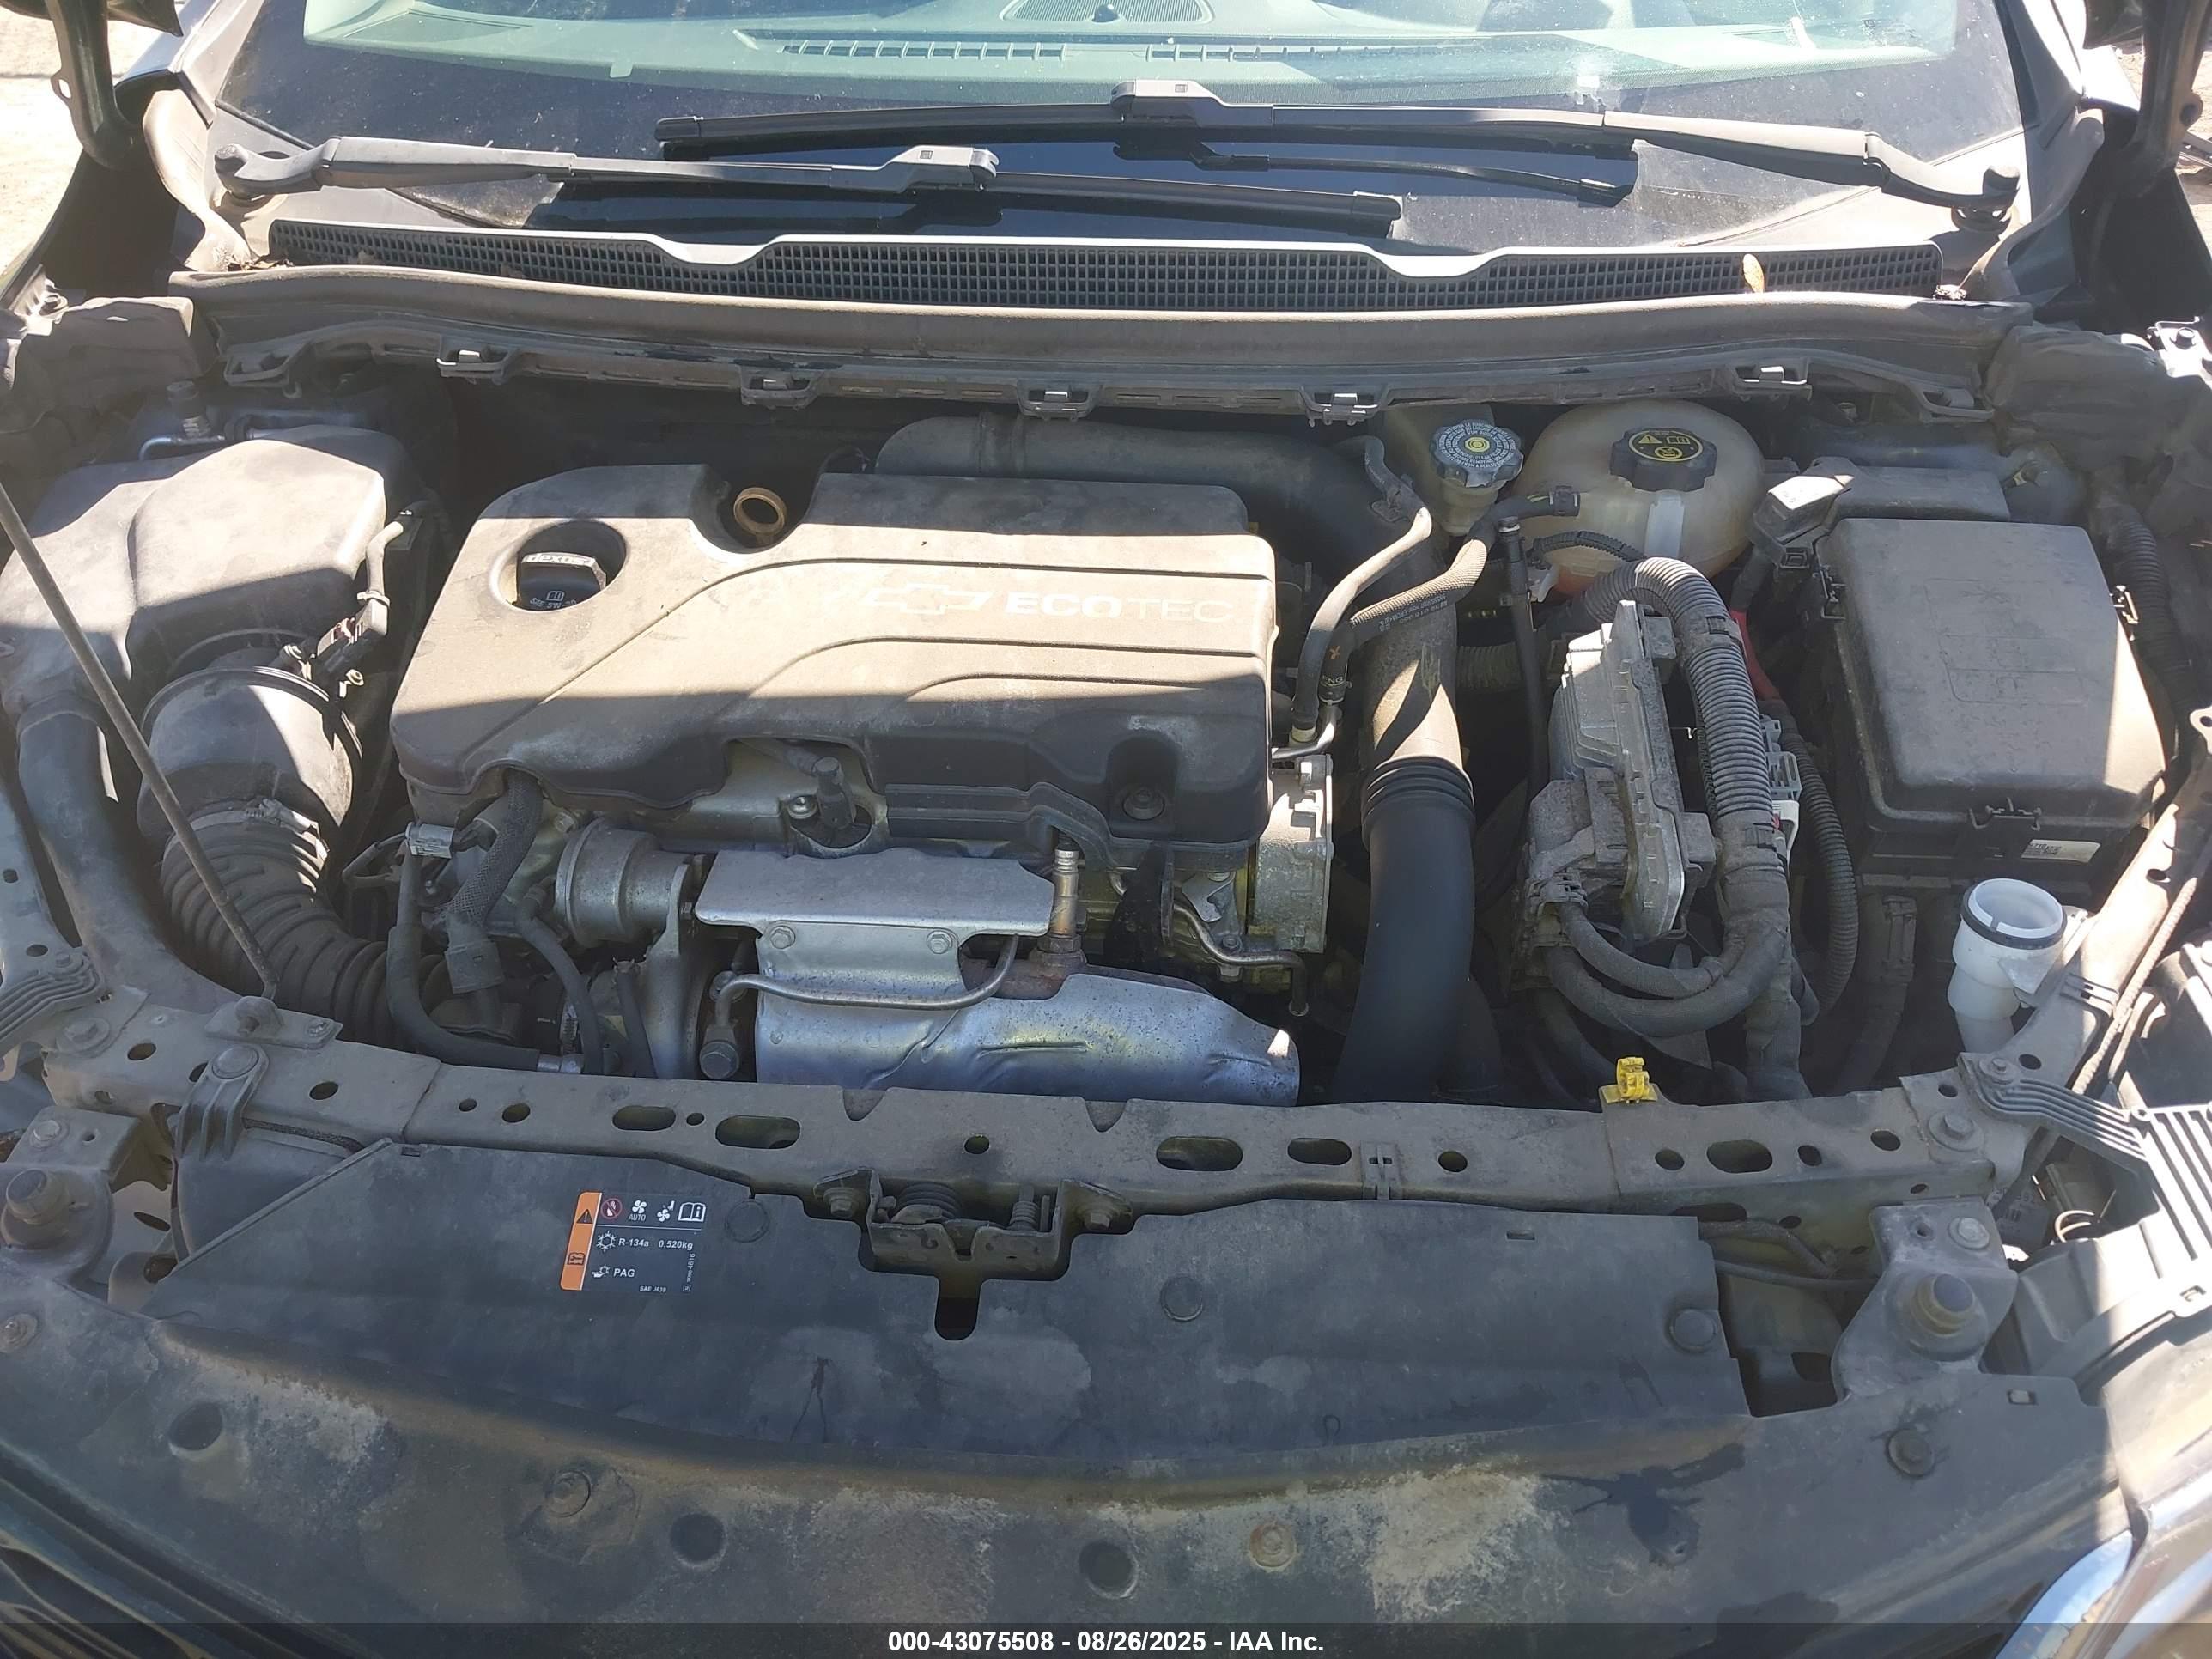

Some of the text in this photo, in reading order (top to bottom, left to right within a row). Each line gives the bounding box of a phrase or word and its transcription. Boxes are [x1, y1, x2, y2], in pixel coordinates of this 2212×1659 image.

[1004, 592, 1234, 623] ECOTEC
[628, 1212, 647, 1222] AUTO
[618, 1237, 693, 1251] R-134a 0.520kg
[613, 1267, 635, 1278] PAG
